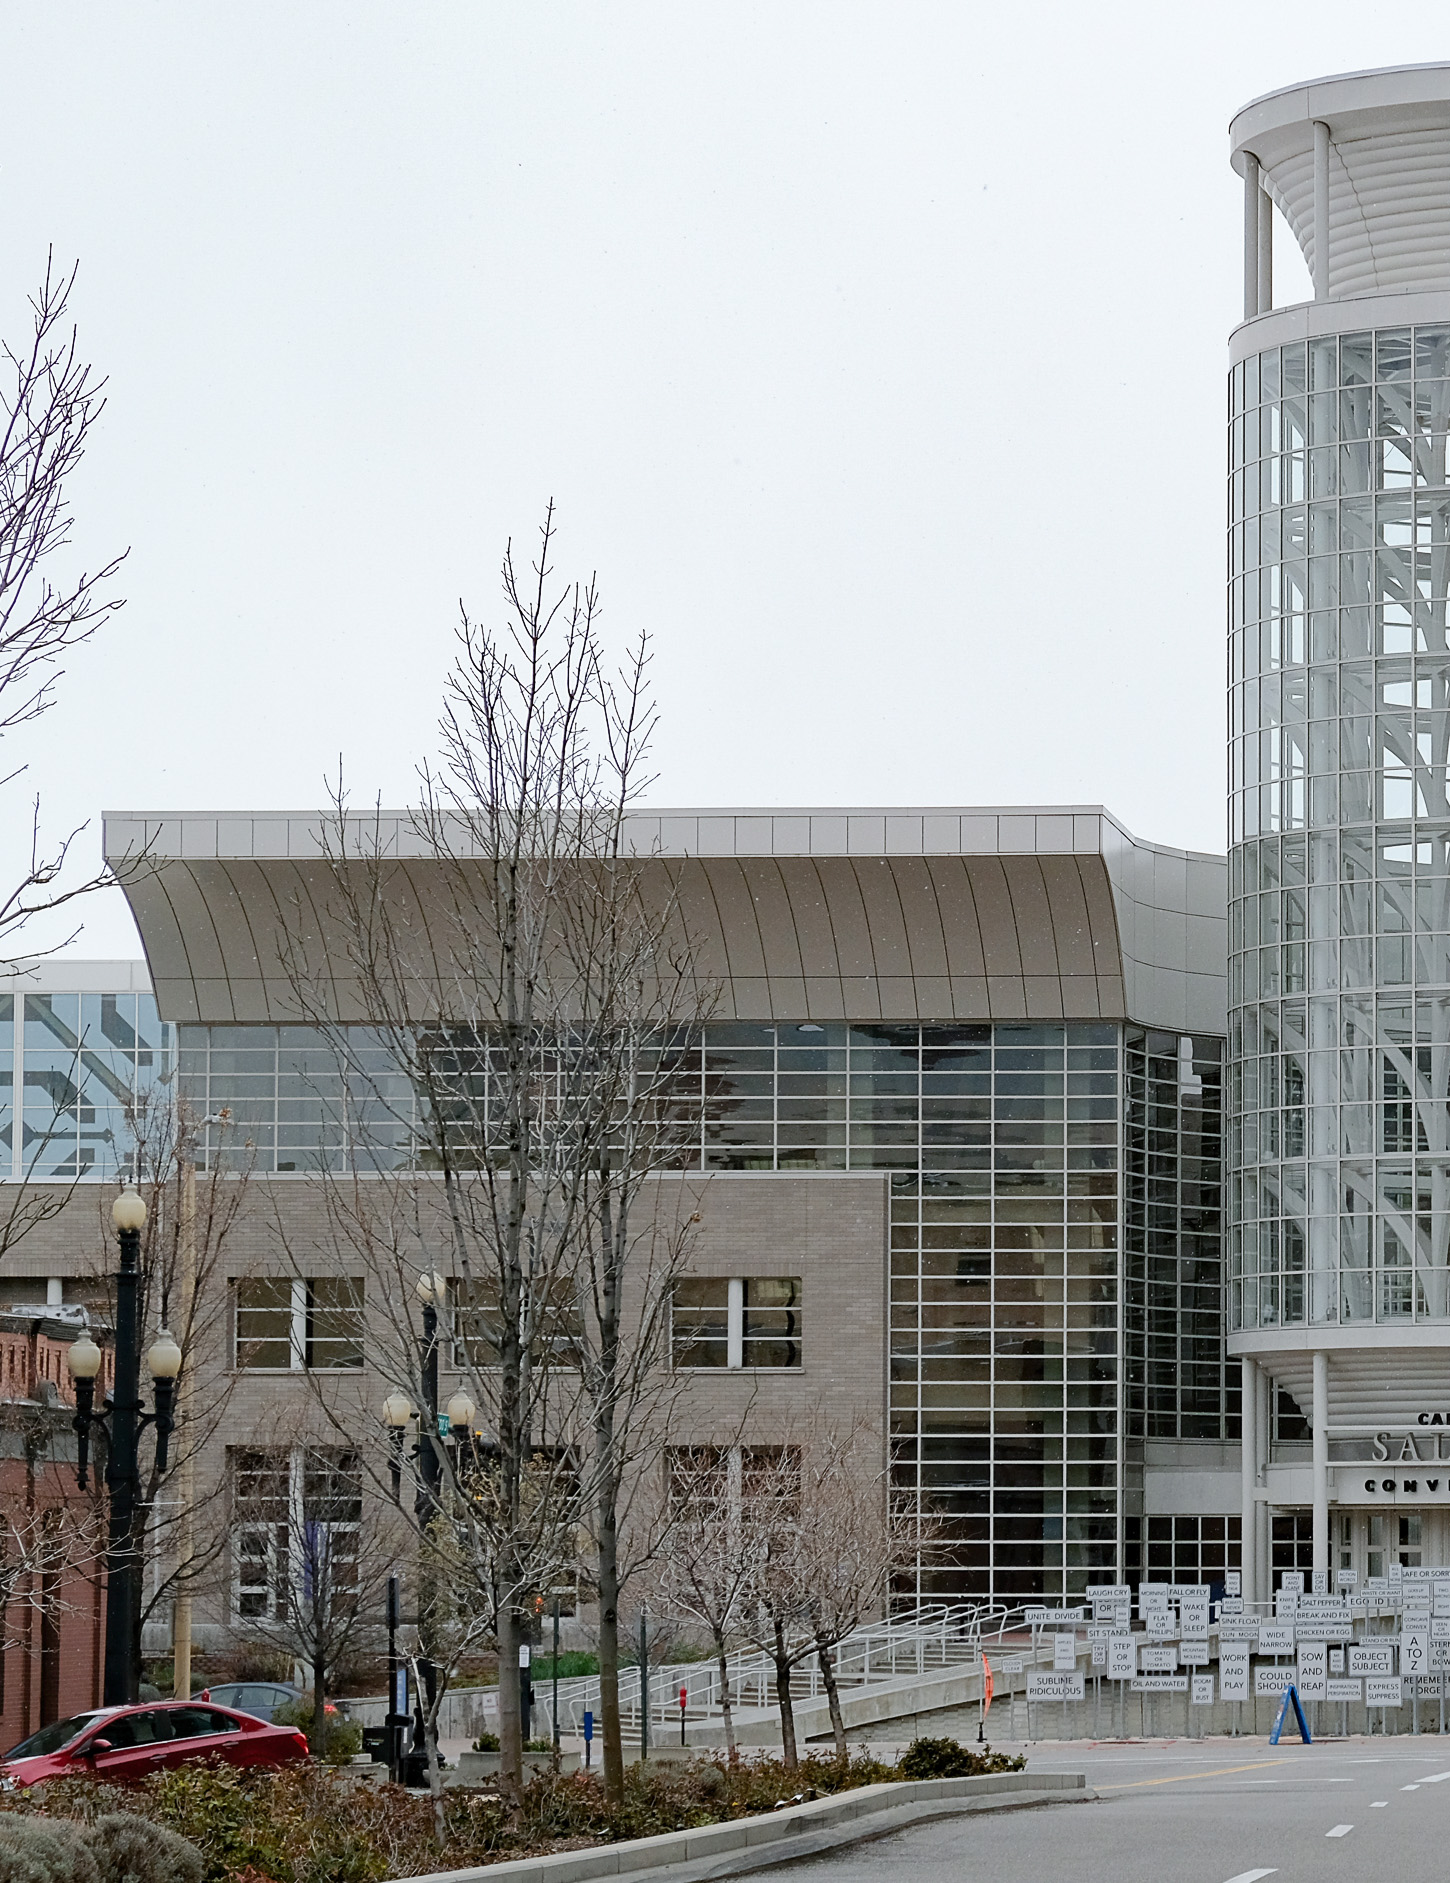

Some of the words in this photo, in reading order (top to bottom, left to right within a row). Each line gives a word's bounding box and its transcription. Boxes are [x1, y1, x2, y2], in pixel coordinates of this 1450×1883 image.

[1054, 1612, 1081, 1620] DIVIDE
[1101, 1629, 1128, 1637] STAND
[1410, 1636, 1419, 1646] A
[1301, 1653, 1324, 1661] SOW
[1353, 1653, 1388, 1661] OBJECT
[1406, 1648, 1423, 1658] TO
[1410, 1661, 1418, 1670] Z
[1260, 1672, 1293, 1680] COULD
[1036, 1677, 1074, 1685] SUBLIME
[1301, 1682, 1324, 1690] REAP
[1029, 1687, 1081, 1695] RIDICULOUS
